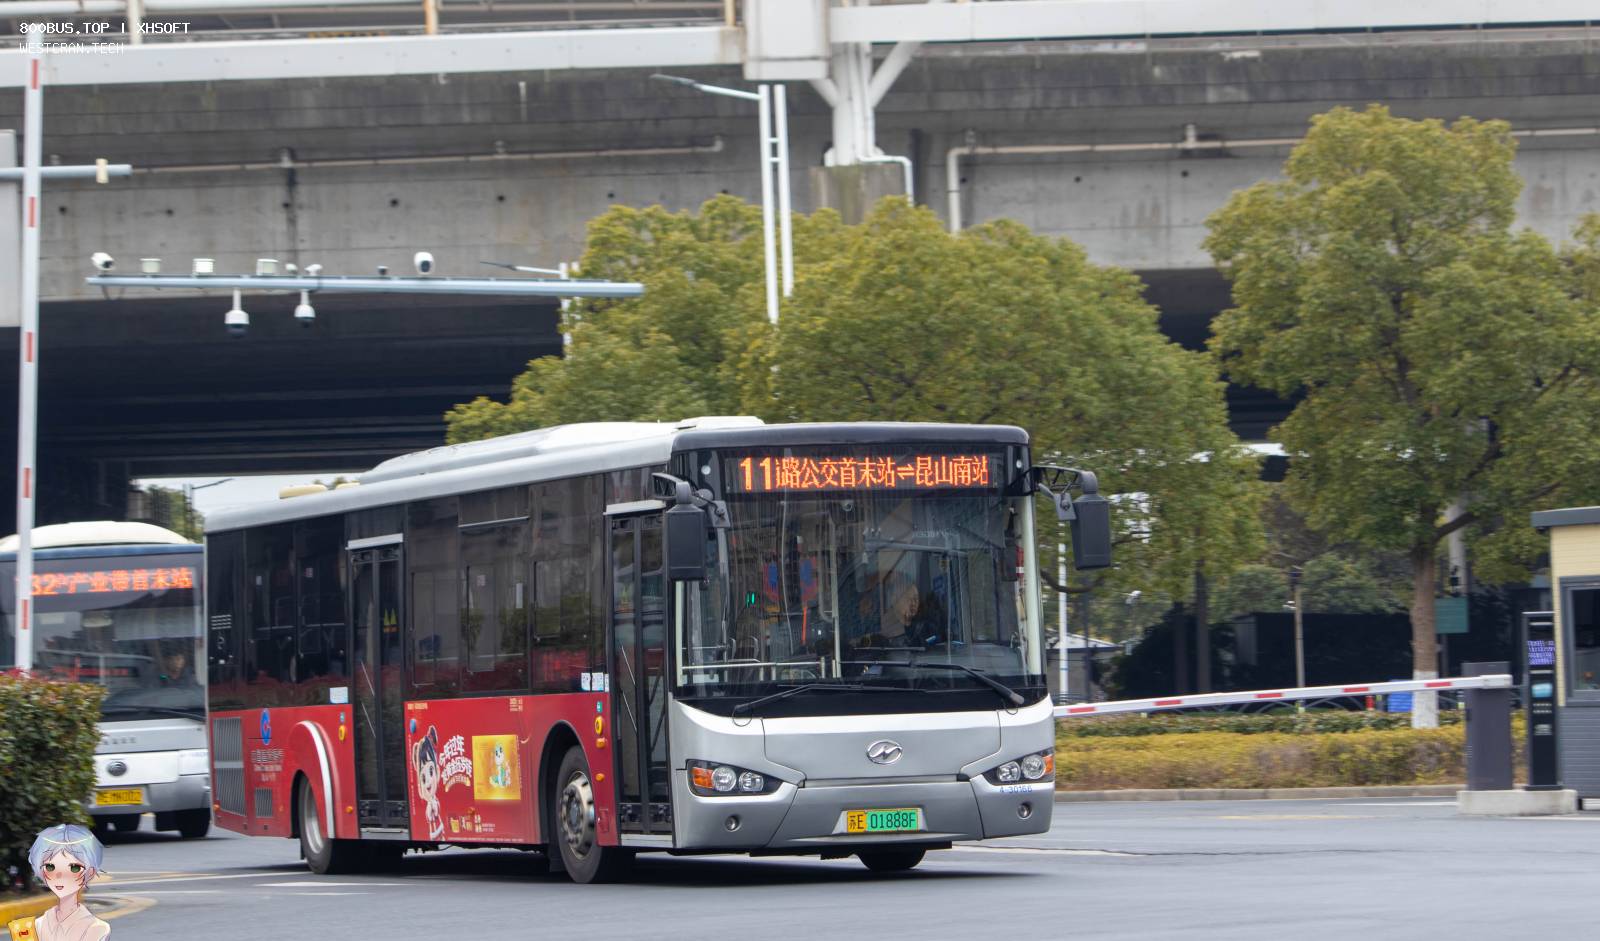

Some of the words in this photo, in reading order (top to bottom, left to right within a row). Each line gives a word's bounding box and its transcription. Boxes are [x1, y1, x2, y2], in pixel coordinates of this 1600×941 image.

[915, 455, 989, 487] 昆山南站
[870, 812, 916, 829] 01888F
